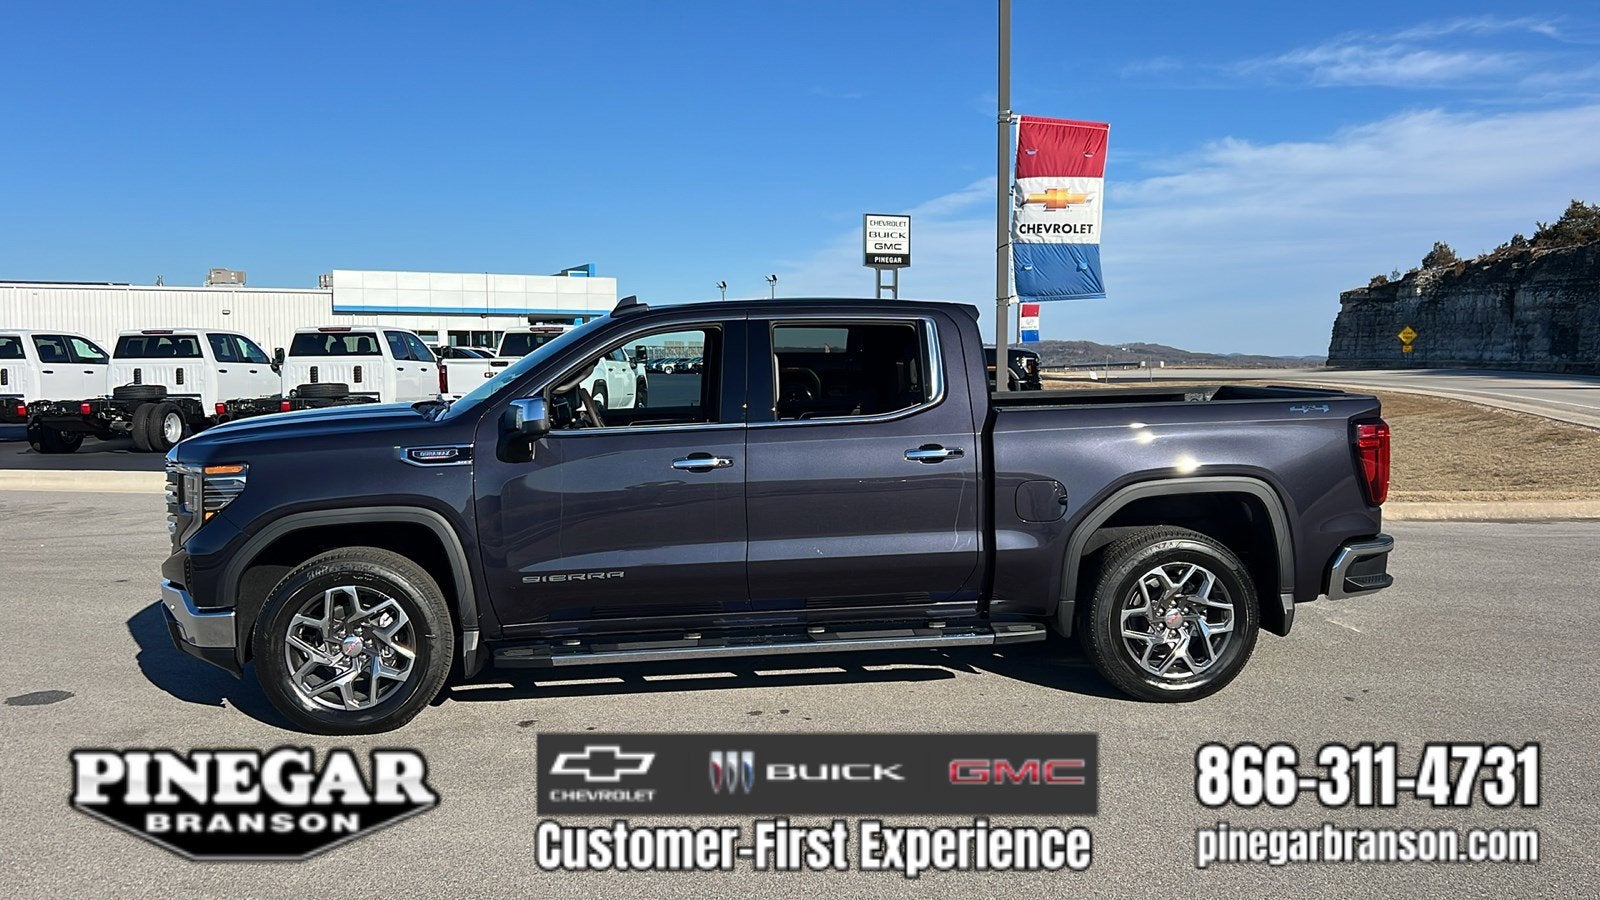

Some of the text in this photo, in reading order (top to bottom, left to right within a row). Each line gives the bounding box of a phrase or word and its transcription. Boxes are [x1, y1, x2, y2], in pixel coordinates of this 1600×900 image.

[869, 219, 907, 228] CHEVROLET
[1018, 222, 1094, 236] CHEVROLET
[868, 231, 907, 239] BUICK
[874, 242, 902, 251] GMC
[874, 256, 903, 264] PINEGAR
[522, 570, 625, 584] SIERRA
